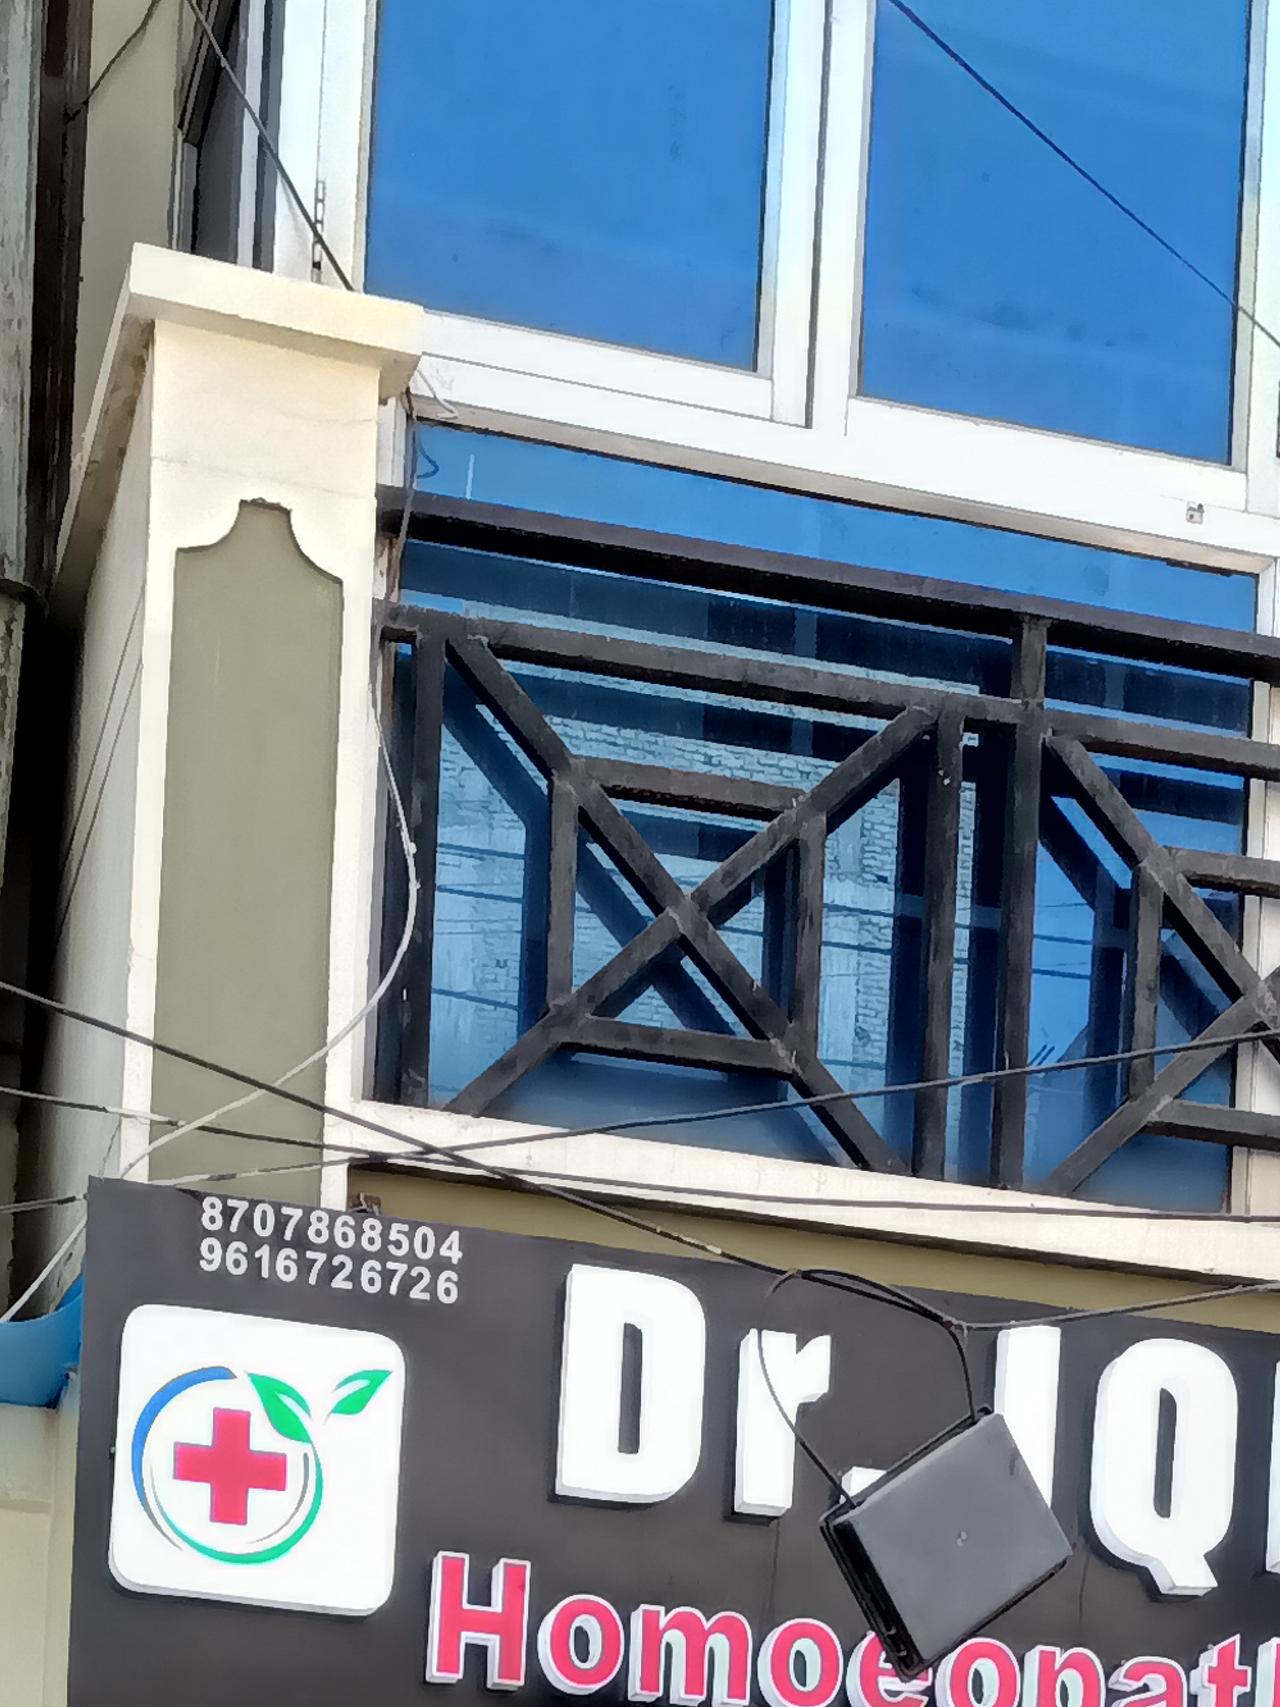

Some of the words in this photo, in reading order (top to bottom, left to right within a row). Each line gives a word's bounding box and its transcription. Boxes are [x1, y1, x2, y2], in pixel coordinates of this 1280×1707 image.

[201, 1196, 463, 1264] 8707868504
[199, 1237, 459, 1305] 9616726726
[554, 1263, 886, 1518] Dr
